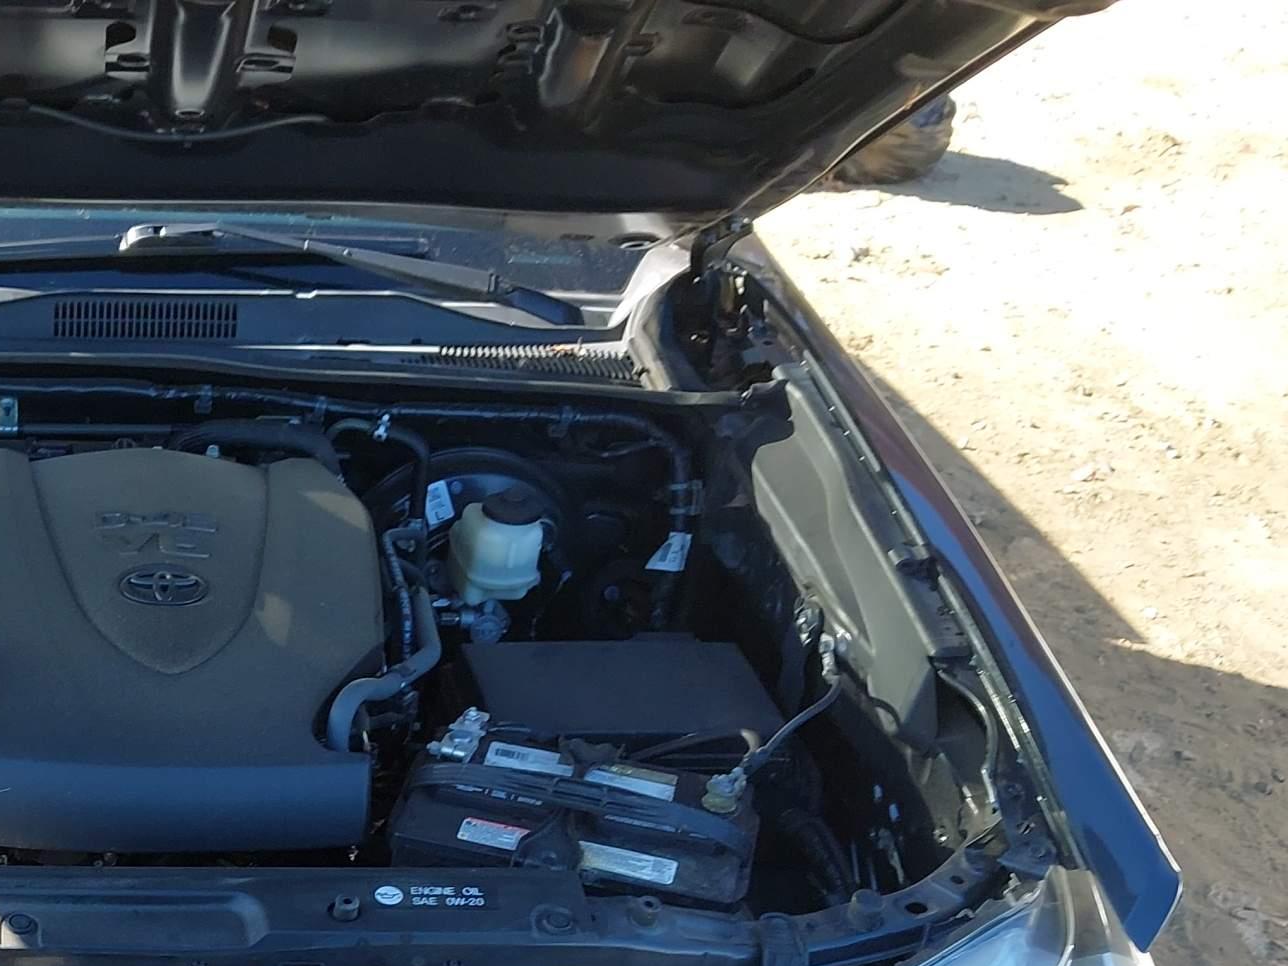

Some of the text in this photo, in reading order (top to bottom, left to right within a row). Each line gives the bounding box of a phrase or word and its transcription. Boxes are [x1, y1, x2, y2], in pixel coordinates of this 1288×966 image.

[409, 885, 484, 896] ENGINE OIL
[411, 896, 485, 906] SAE 0W-20
